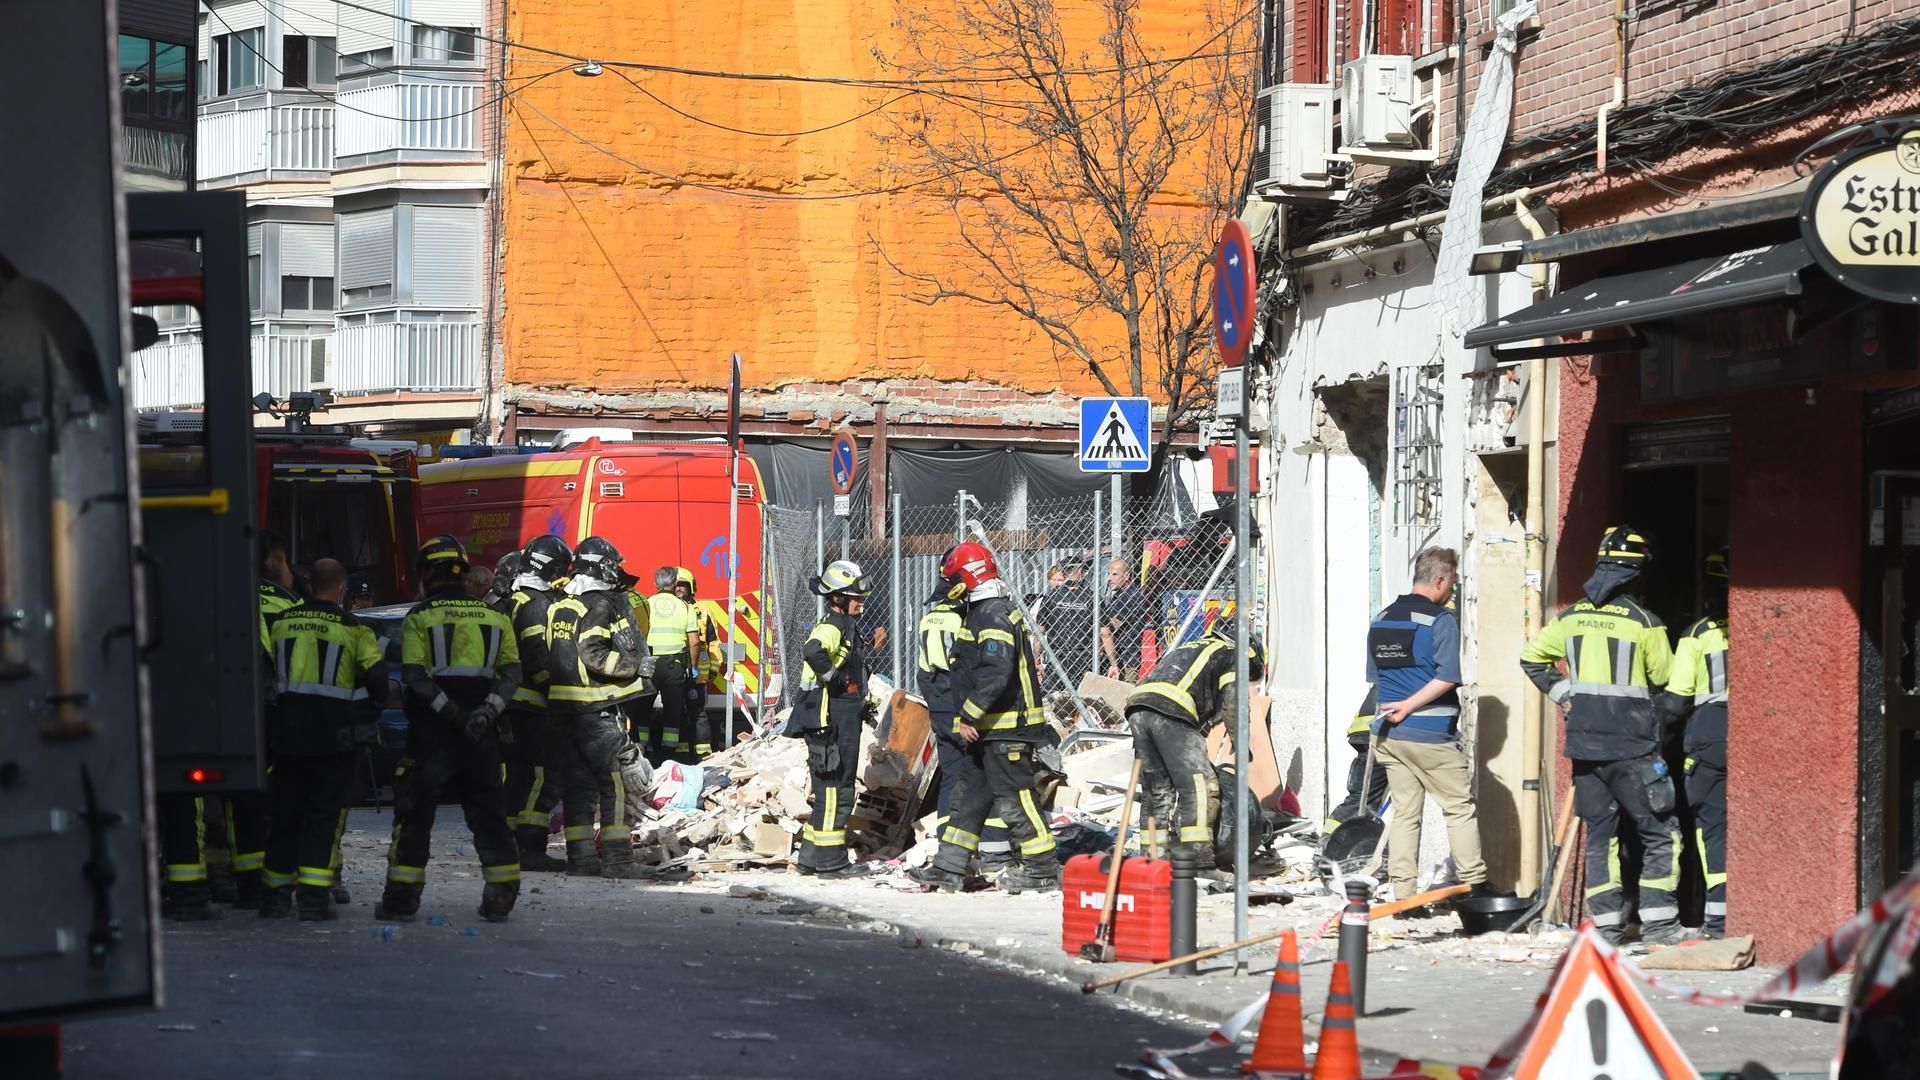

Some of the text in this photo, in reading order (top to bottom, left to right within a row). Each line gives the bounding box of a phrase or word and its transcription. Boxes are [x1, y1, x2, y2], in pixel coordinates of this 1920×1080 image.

[472, 512, 512, 528] BOMBEROS
[477, 528, 503, 544] MADRID
[431, 599, 488, 608] BOMBEROS
[283, 610, 343, 622] BOMBEROS
[445, 610, 486, 619] MADRID
[288, 623, 329, 633] MADRID
[1577, 619, 1615, 630] MADRID
